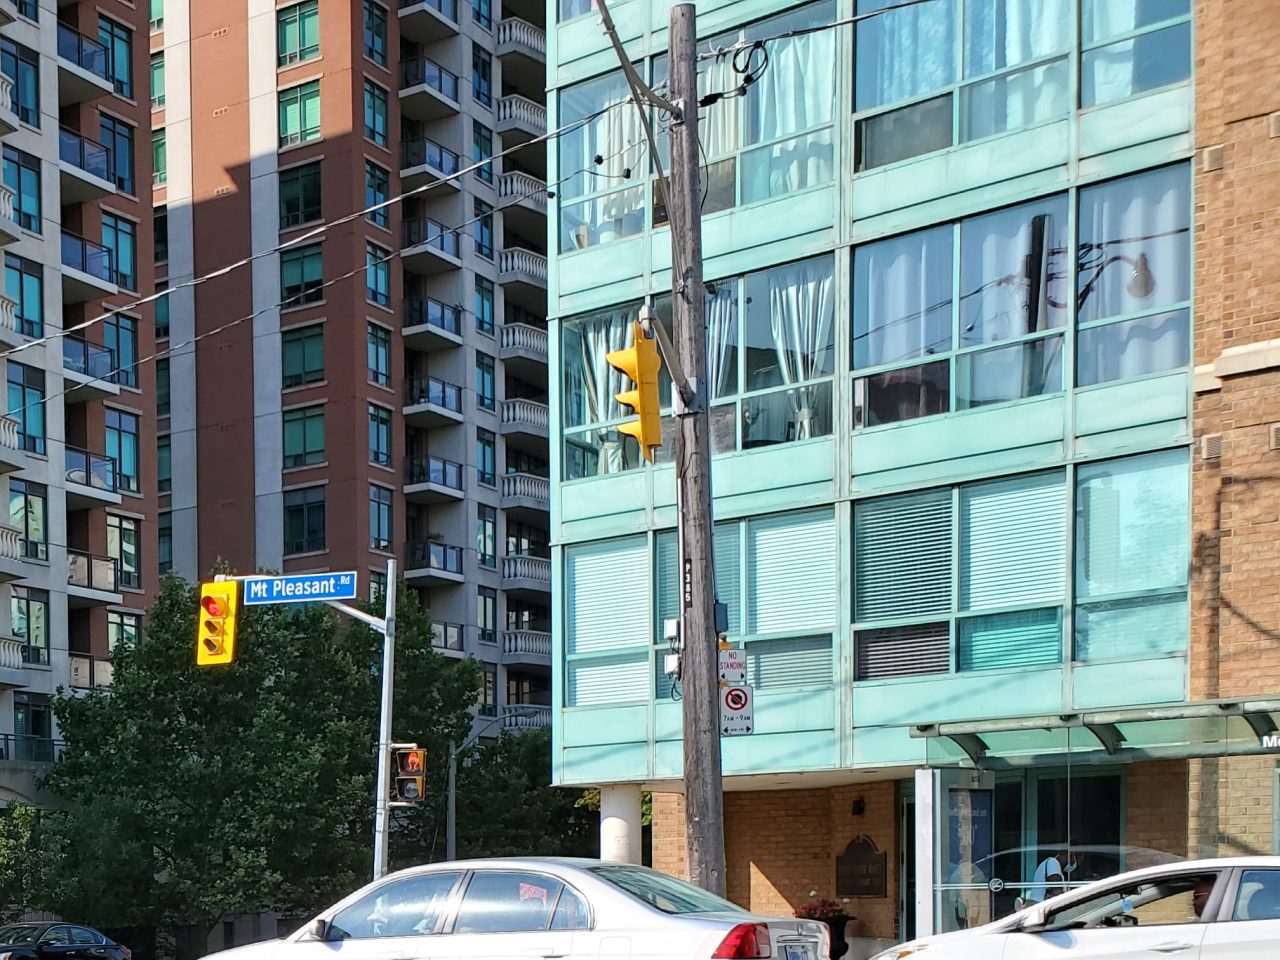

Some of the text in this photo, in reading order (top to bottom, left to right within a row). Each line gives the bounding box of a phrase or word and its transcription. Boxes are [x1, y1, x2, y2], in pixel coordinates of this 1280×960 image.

[251, 576, 350, 598] Mt Pleasant Rd
[728, 651, 737, 660] NO
[720, 661, 746, 670] STANDING
